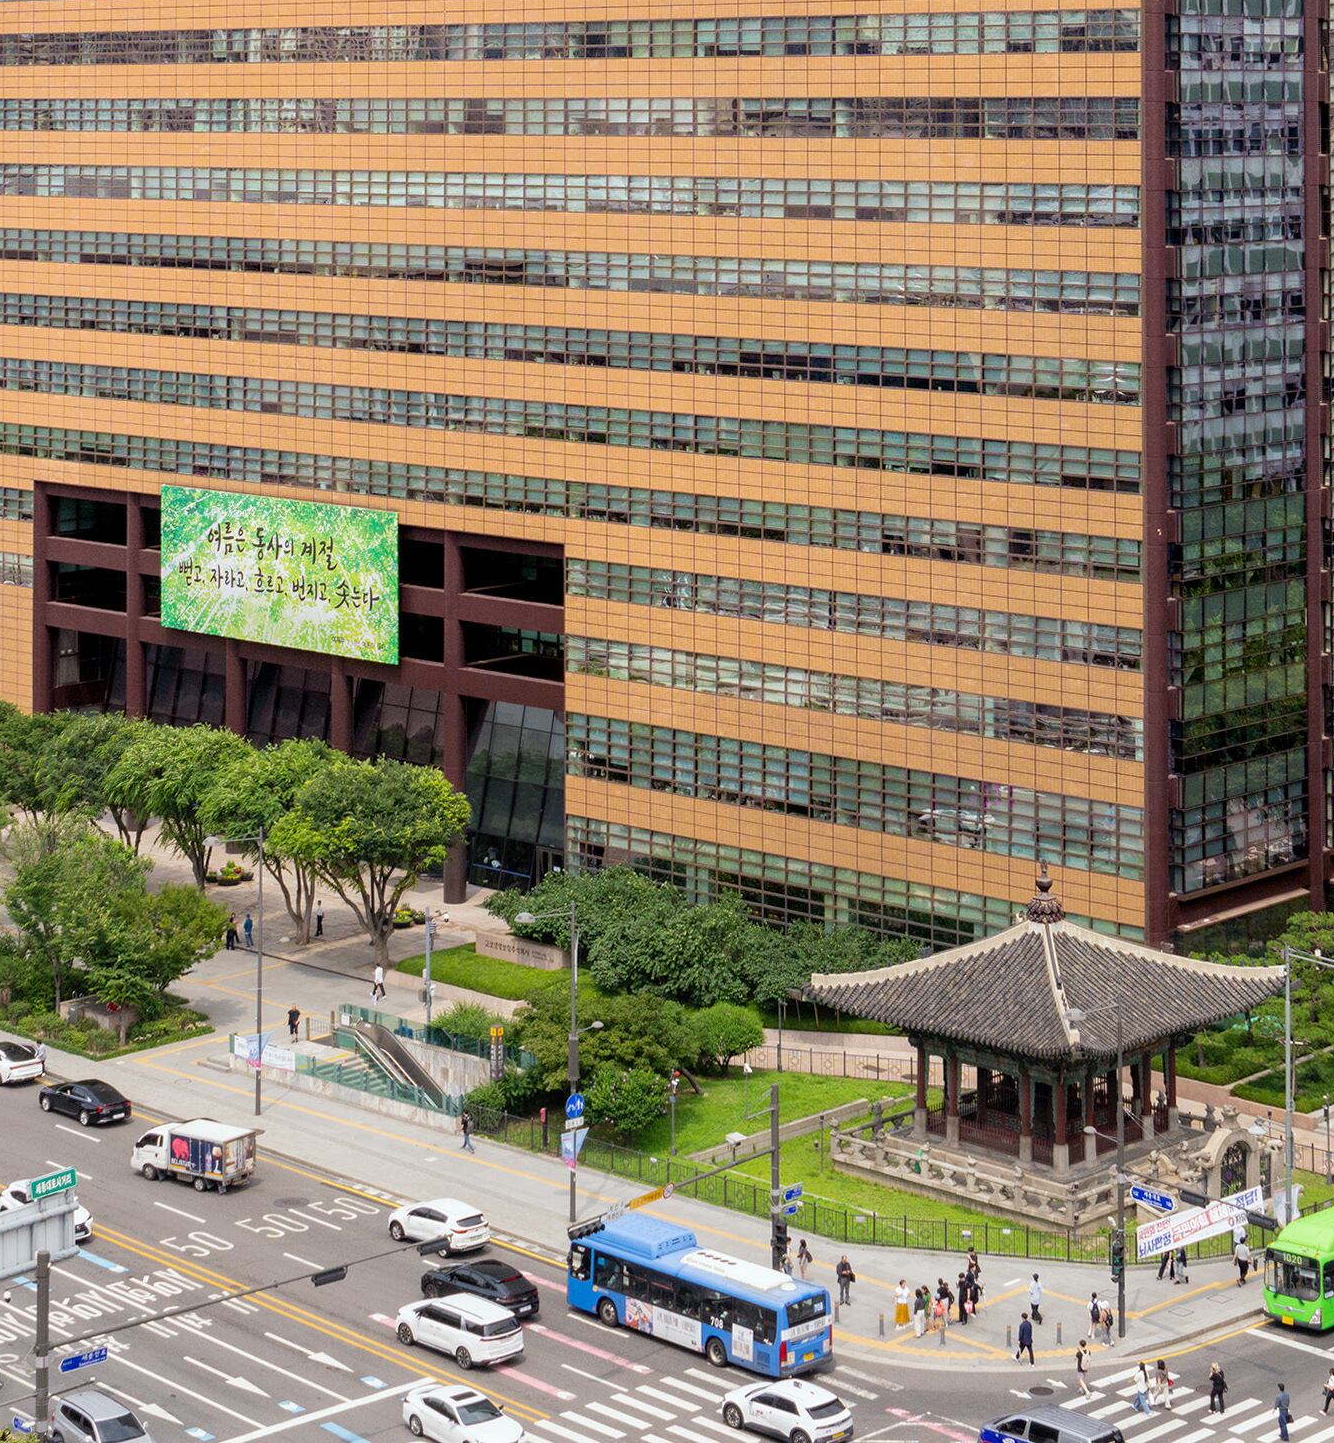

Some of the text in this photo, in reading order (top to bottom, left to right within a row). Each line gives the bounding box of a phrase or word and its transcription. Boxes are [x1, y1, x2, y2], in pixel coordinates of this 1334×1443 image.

[208, 521, 338, 571] 여름은 동사의 계절
[178, 556, 380, 612] 뻗고, 자라고, 흐르고, 번지고, 솟는다
[307, 1197, 381, 1221] 50
[235, 1213, 310, 1238] 50
[160, 1231, 235, 1257] 50
[1283, 1252, 1303, 1265] 1020
[710, 1316, 724, 1329] 708
